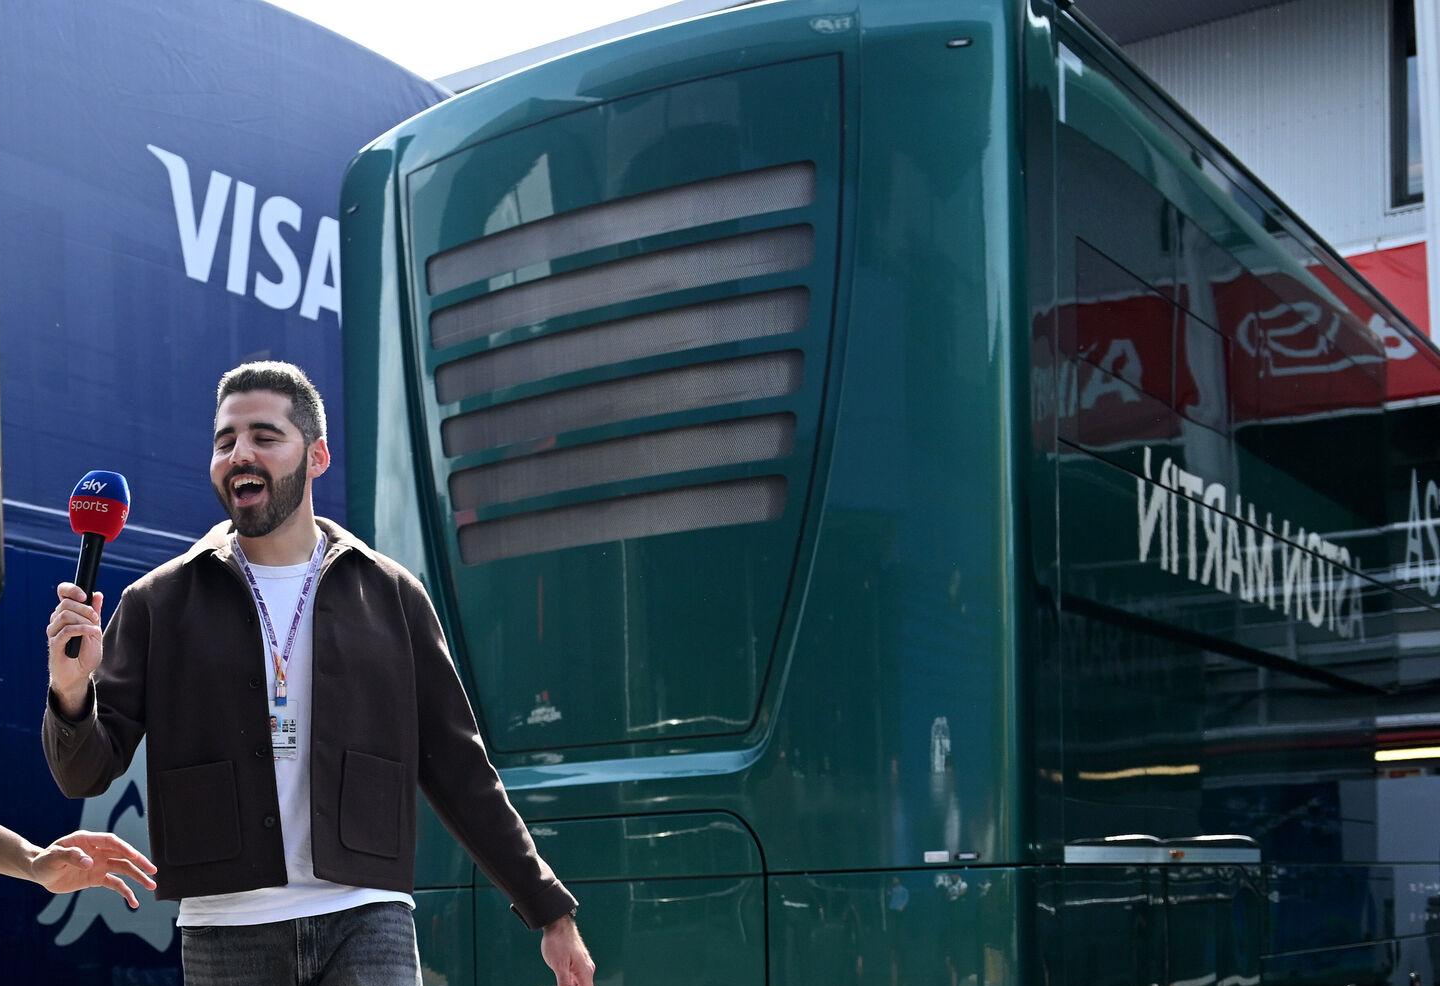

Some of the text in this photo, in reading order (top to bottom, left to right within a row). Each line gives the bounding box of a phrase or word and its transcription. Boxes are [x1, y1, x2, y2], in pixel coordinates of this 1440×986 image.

[146, 143, 342, 329] VISA
[81, 478, 108, 494] sky
[71, 499, 109, 514] sports
[302, 576, 313, 596] MEDIA
